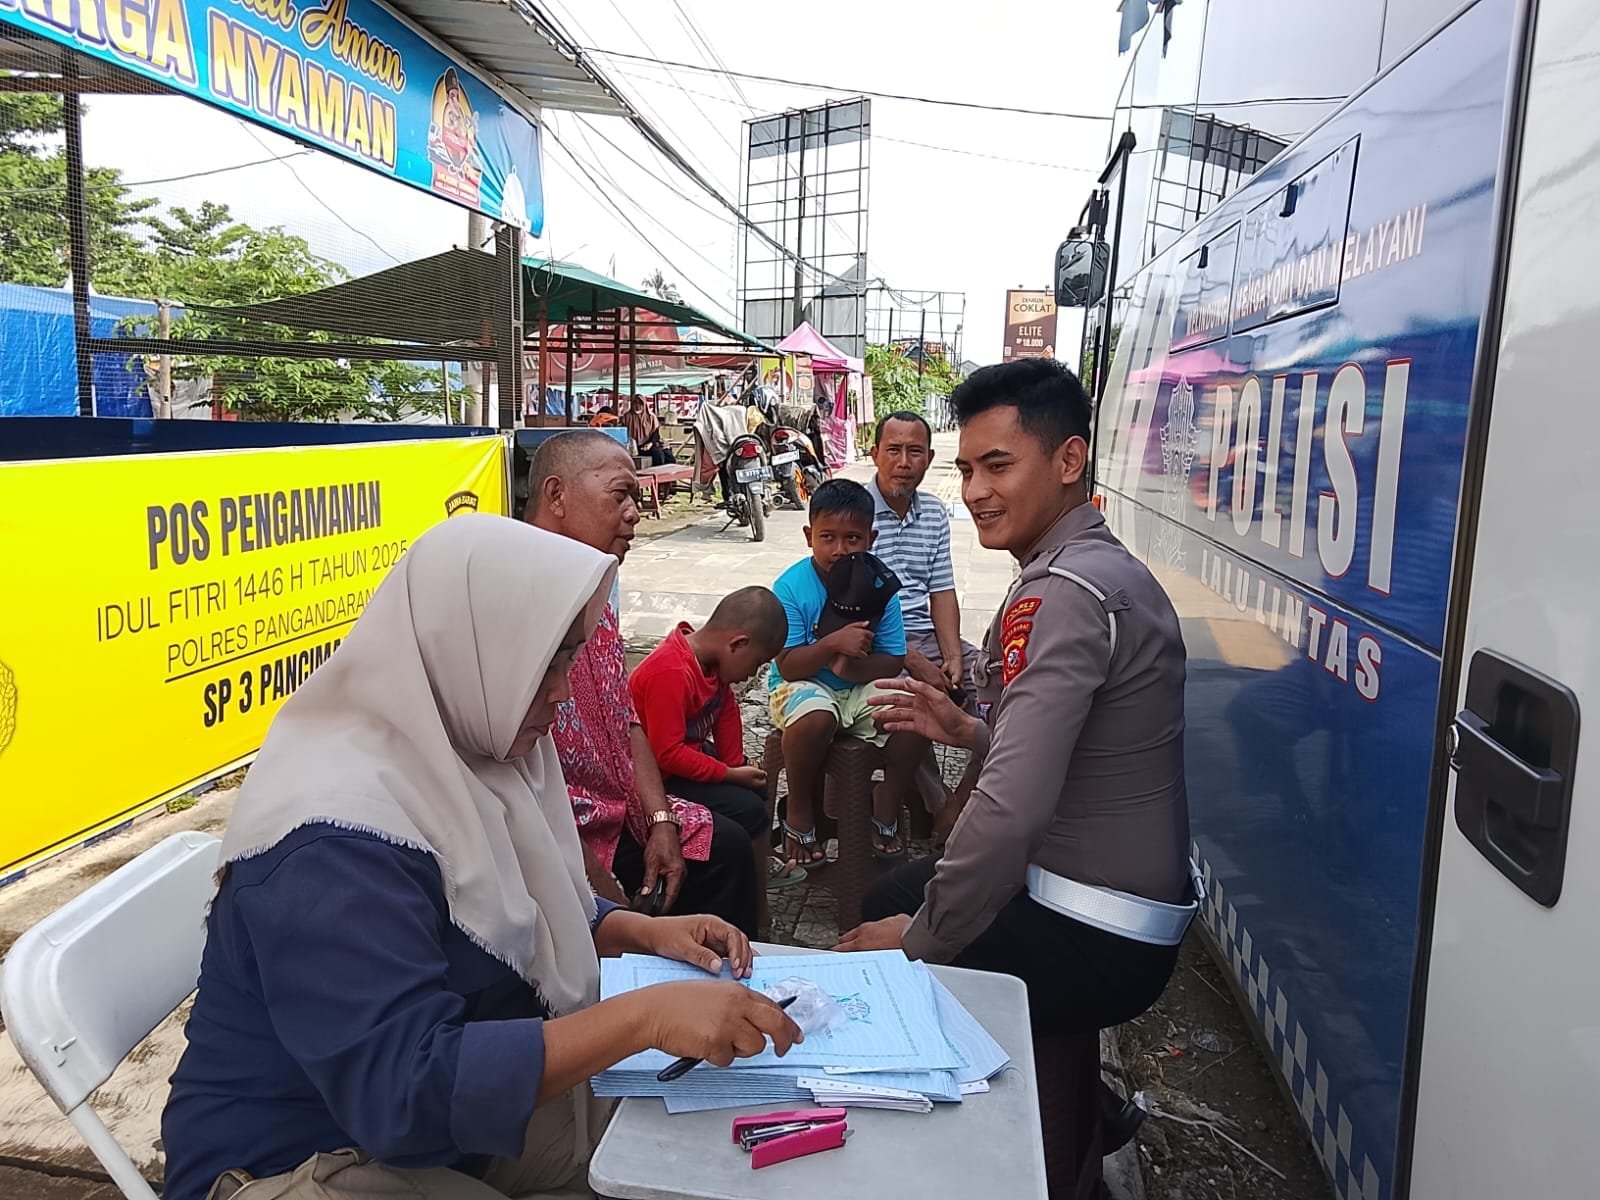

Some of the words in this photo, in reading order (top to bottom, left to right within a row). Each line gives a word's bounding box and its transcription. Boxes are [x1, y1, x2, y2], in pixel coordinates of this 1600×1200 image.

[0, 0, 197, 85] GA
[209, 9, 395, 171] NYAMAN
[300, 0, 403, 92] Aman
[1297, 249, 1330, 297] DAN
[1329, 203, 1427, 285] MELAYANI
[1013, 304, 1052, 312] COKLAT
[1019, 326, 1043, 336] ELITE
[1208, 358, 1411, 596] POLISI
[147, 500, 210, 570] POS
[220, 480, 381, 556] PENGAMANAN
[97, 596, 160, 642] IDUL
[169, 579, 226, 624] FITRI
[234, 567, 284, 606] 1446
[290, 562, 304, 592] H
[309, 548, 367, 587] TAHUN
[372, 539, 408, 571] 2025
[168, 624, 249, 673] POLRES
[255, 588, 376, 646] PANGANDARAN
[1200, 549, 1250, 612] LALU
[1256, 578, 1383, 702] LINTAS
[203, 678, 232, 728] SP
[239, 670, 253, 714] 3
[260, 638, 341, 706] PANCIM
